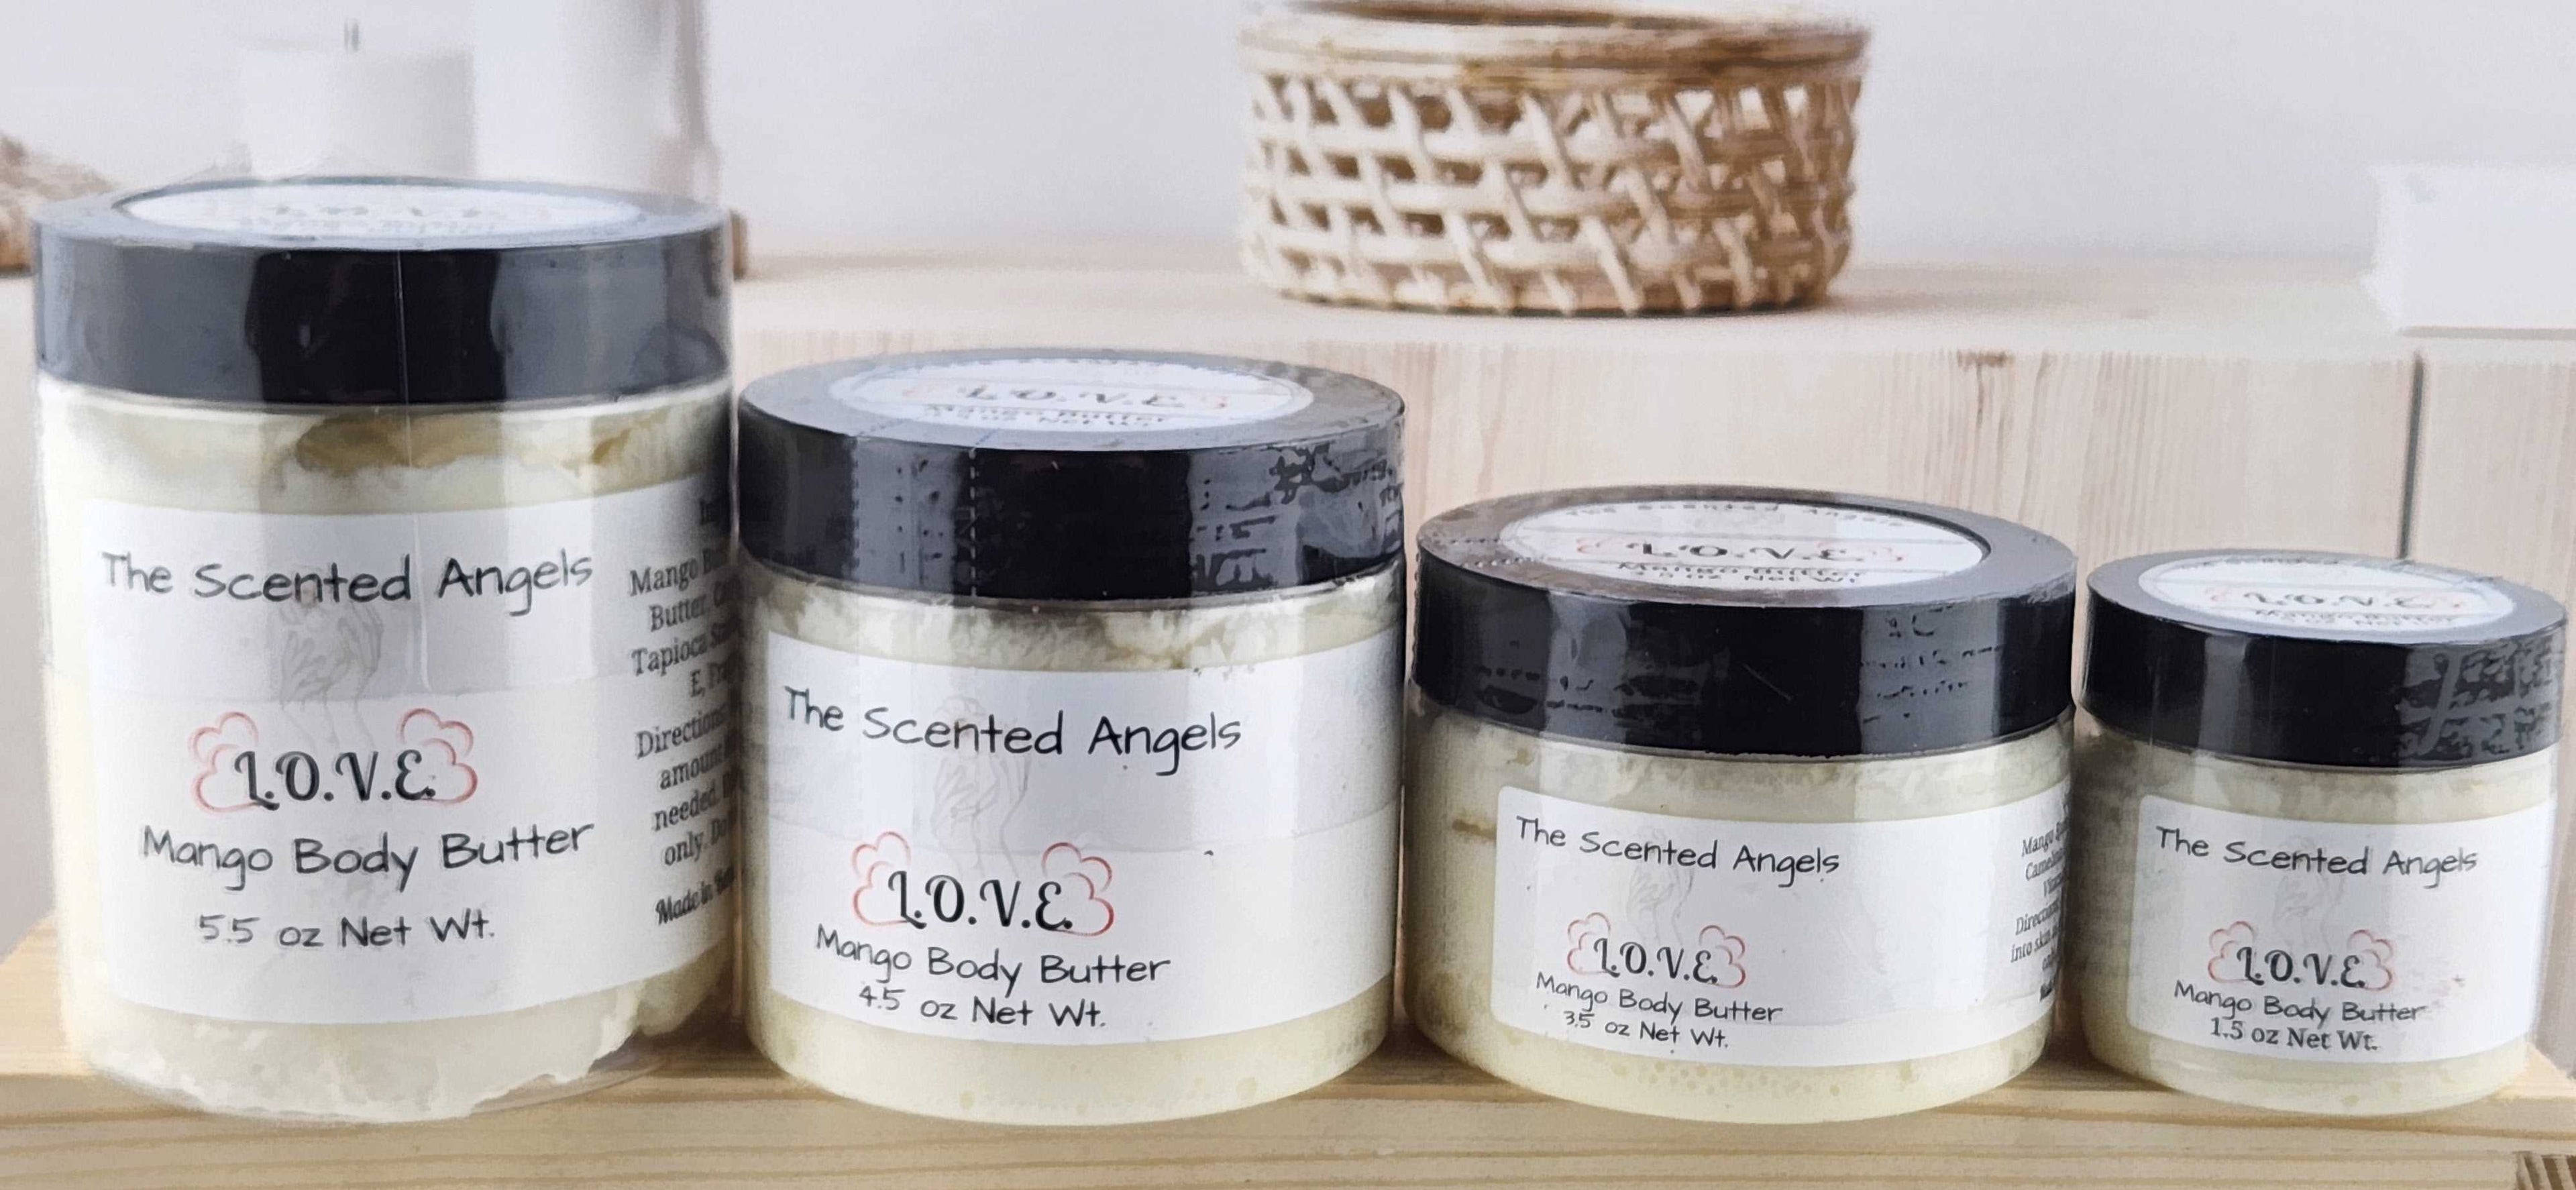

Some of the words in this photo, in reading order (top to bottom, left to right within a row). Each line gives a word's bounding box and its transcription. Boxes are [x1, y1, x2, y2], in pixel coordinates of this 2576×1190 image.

[101, 551, 174, 596] The
[193, 555, 411, 602] Scented
[437, 549, 595, 615] Angels
[629, 557, 698, 596] Mango
[631, 633, 708, 677] Tapioca
[784, 686, 845, 732] The
[862, 707, 1065, 755] Scented
[1087, 711, 1242, 776] Angels
[141, 824, 274, 890] Mango
[295, 833, 419, 891] Body
[441, 822, 596, 869] Butter
[1515, 814, 1566, 847] The
[1578, 831, 1719, 870] Scented
[1732, 844, 1840, 888] Angels
[2155, 825, 2210, 858] The
[2222, 841, 2369, 875] Scented
[2382, 846, 2480, 889] Angels
[197, 914, 254, 945] 5.5
[278, 923, 323, 947] oz
[341, 910, 410, 948] Net
[430, 908, 495, 943] Wt.
[815, 924, 913, 984] Mango
[926, 946, 1023, 999] Body
[1040, 953, 1172, 985] Butter
[858, 985, 906, 1012] 4.5
[920, 998, 959, 1021] oz
[971, 997, 1034, 1026] Net
[1049, 999, 1107, 1028] Wt.
[1536, 971, 1609, 1012] Mango
[1619, 988, 1684, 1025] Body
[1694, 997, 1784, 1022] Butter
[2174, 979, 2253, 1020] Mango
[2263, 995, 2331, 1029] Body
[2341, 1001, 2428, 1023] Butter
[1563, 1010, 1595, 1029] 3.5
[1604, 1021, 1631, 1036] oz
[1640, 1021, 1680, 1043] Net
[1690, 1027, 1729, 1048] Wt.
[2210, 1016, 2245, 1040] 1.5
[2251, 1027, 2279, 1044] oz
[2286, 1026, 2330, 1050] Net
[2335, 1029, 2378, 1051] Wt.
